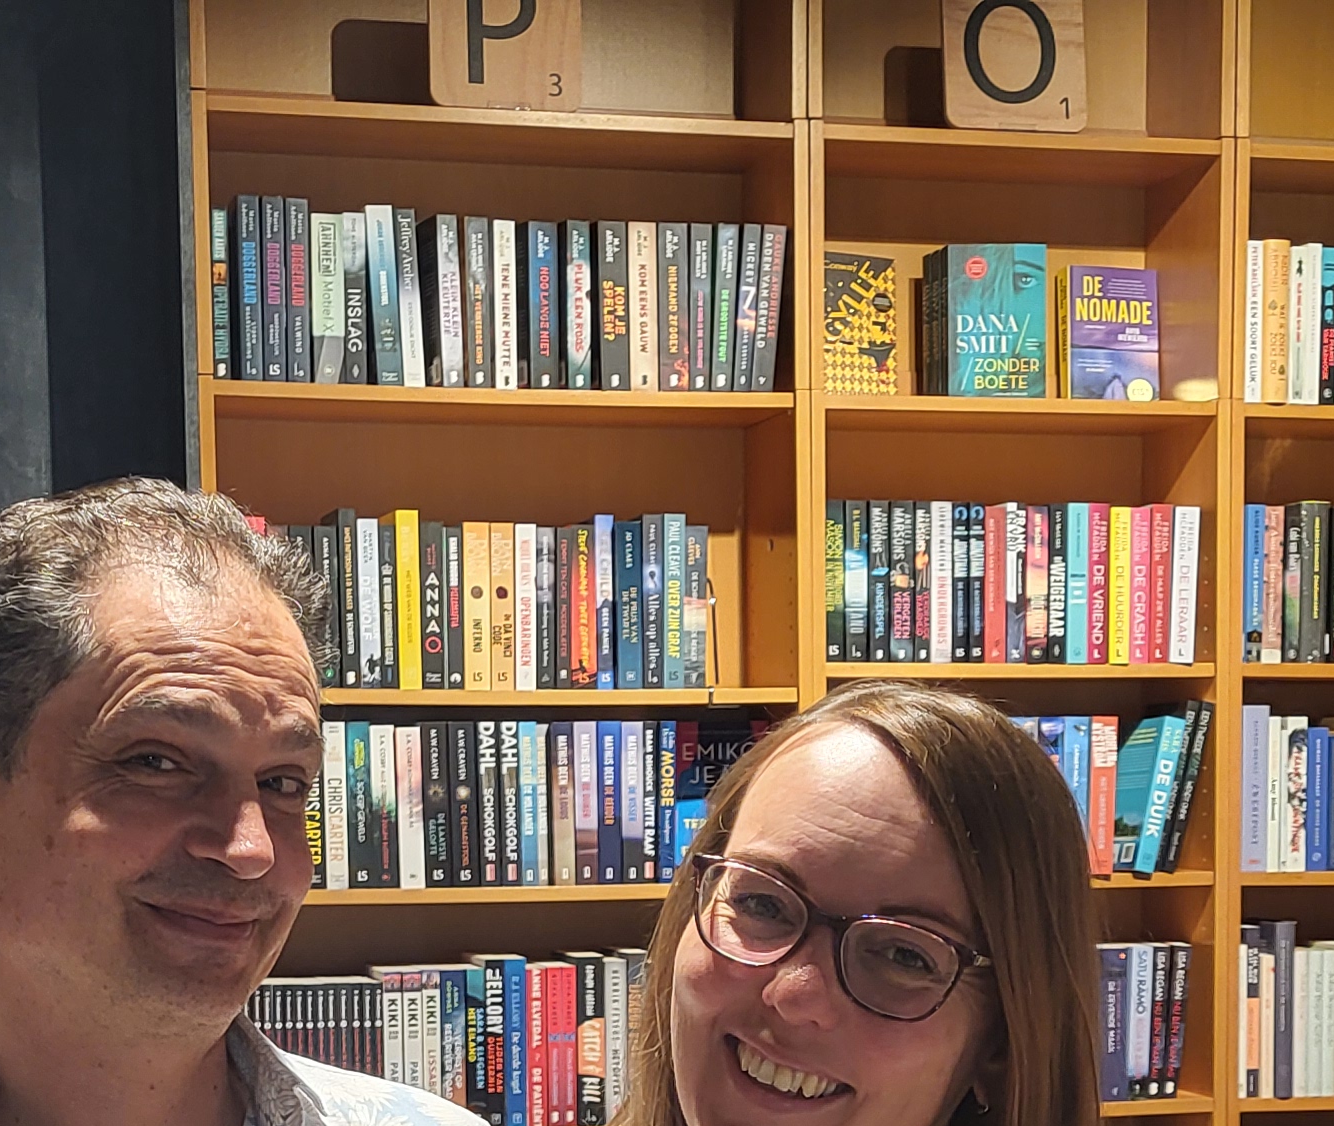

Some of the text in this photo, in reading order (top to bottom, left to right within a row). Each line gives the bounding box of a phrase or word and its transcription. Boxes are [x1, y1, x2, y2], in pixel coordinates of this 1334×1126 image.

[468, 0, 536, 84] P
[963, 0, 1056, 104] O
[547, 73, 563, 98] 3
[1058, 96, 1070, 120] 1
[242, 241, 257, 304] DOGGERLAND
[267, 242, 281, 305] DOGGERLAND
[291, 243, 305, 306] DOGGERLAND
[397, 214, 416, 291] Jeffrey Archer
[745, 243, 756, 284] MICKEY
[602, 280, 615, 341] SPELEN?
[614, 286, 626, 335] KOM JE
[638, 264, 649, 318] KOM EENS
[756, 233, 774, 348] DADEN VAN GEWELD
[767, 275, 780, 338] ANDRIESSE
[1074, 298, 1153, 325] NOMADE
[1082, 276, 1104, 296] DE
[346, 288, 363, 353] INSLAG
[539, 330, 550, 356] NIET
[956, 313, 1018, 334] DANA
[956, 335, 1010, 354] SMIT
[973, 358, 1040, 373] ZONDER
[974, 375, 1028, 390] BOETE
[893, 508, 905, 560] MARSONS
[424, 572, 440, 634] ANNA
[668, 521, 680, 659] PAUL CLEAVE OVER ZIJN GRAF
[1049, 562, 1066, 637] WEIGERAAR
[1091, 589, 1105, 645] VRIEND
[1177, 588, 1189, 643] LERAAR
[472, 618, 482, 653] INFERNO
[521, 596, 532, 667] OPENBARINGEN
[1134, 591, 1146, 645] CRASH
[478, 722, 496, 861] DAHL SCHOKGOLF
[500, 722, 518, 861] DAHL SCHOKGOLF
[660, 750, 674, 807] MORSE
[1145, 759, 1174, 839] DE DUIK
[643, 796, 655, 857] WITTE RAAF
[532, 968, 542, 998] ANNE
[1137, 951, 1148, 979] SATU
[1177, 951, 1187, 968] LISA
[388, 998, 399, 1028] KIKI
[407, 997, 419, 1028] KIKI
[426, 995, 437, 1024] KIKI
[486, 981, 504, 1034] ELLORY
[532, 1000, 542, 1048] ELVEDAL
[581, 1077, 600, 1104] KILL
